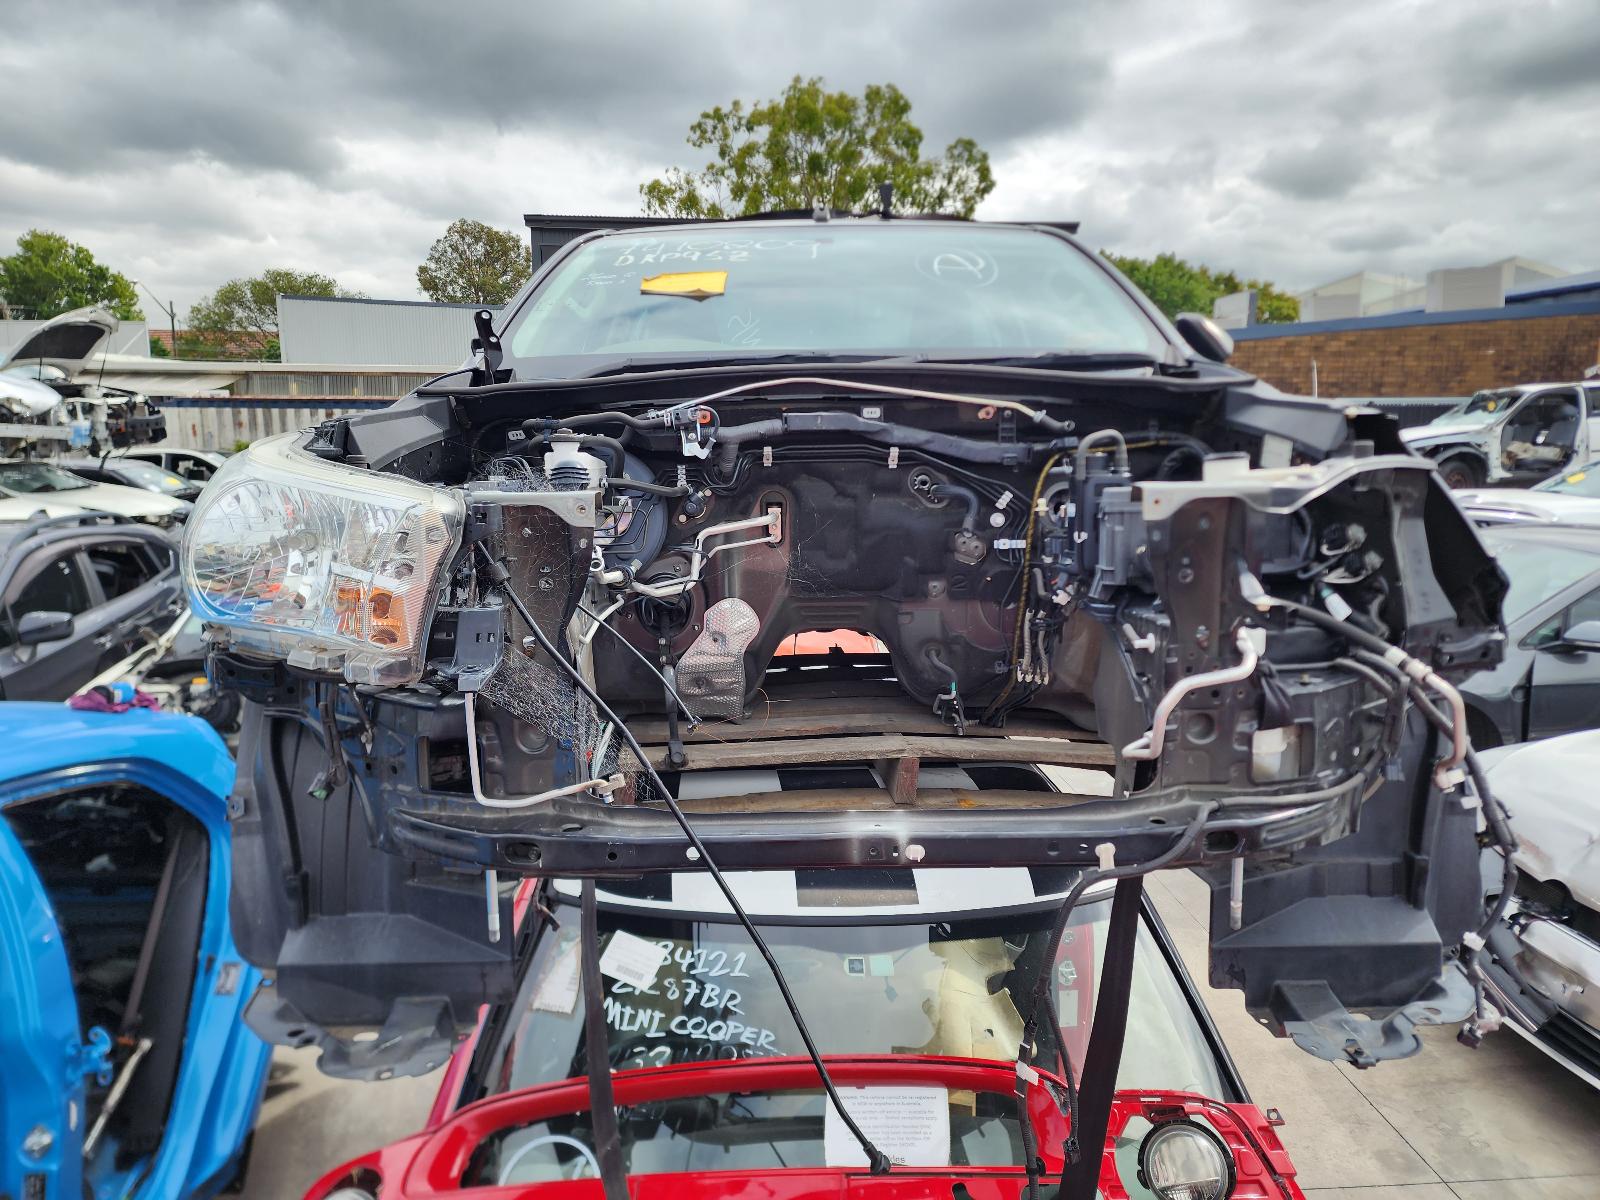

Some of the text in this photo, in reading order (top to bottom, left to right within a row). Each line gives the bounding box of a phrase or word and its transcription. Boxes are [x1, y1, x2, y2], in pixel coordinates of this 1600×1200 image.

[649, 940, 750, 978] 84121
[603, 996, 783, 1055] MINI COOPER
